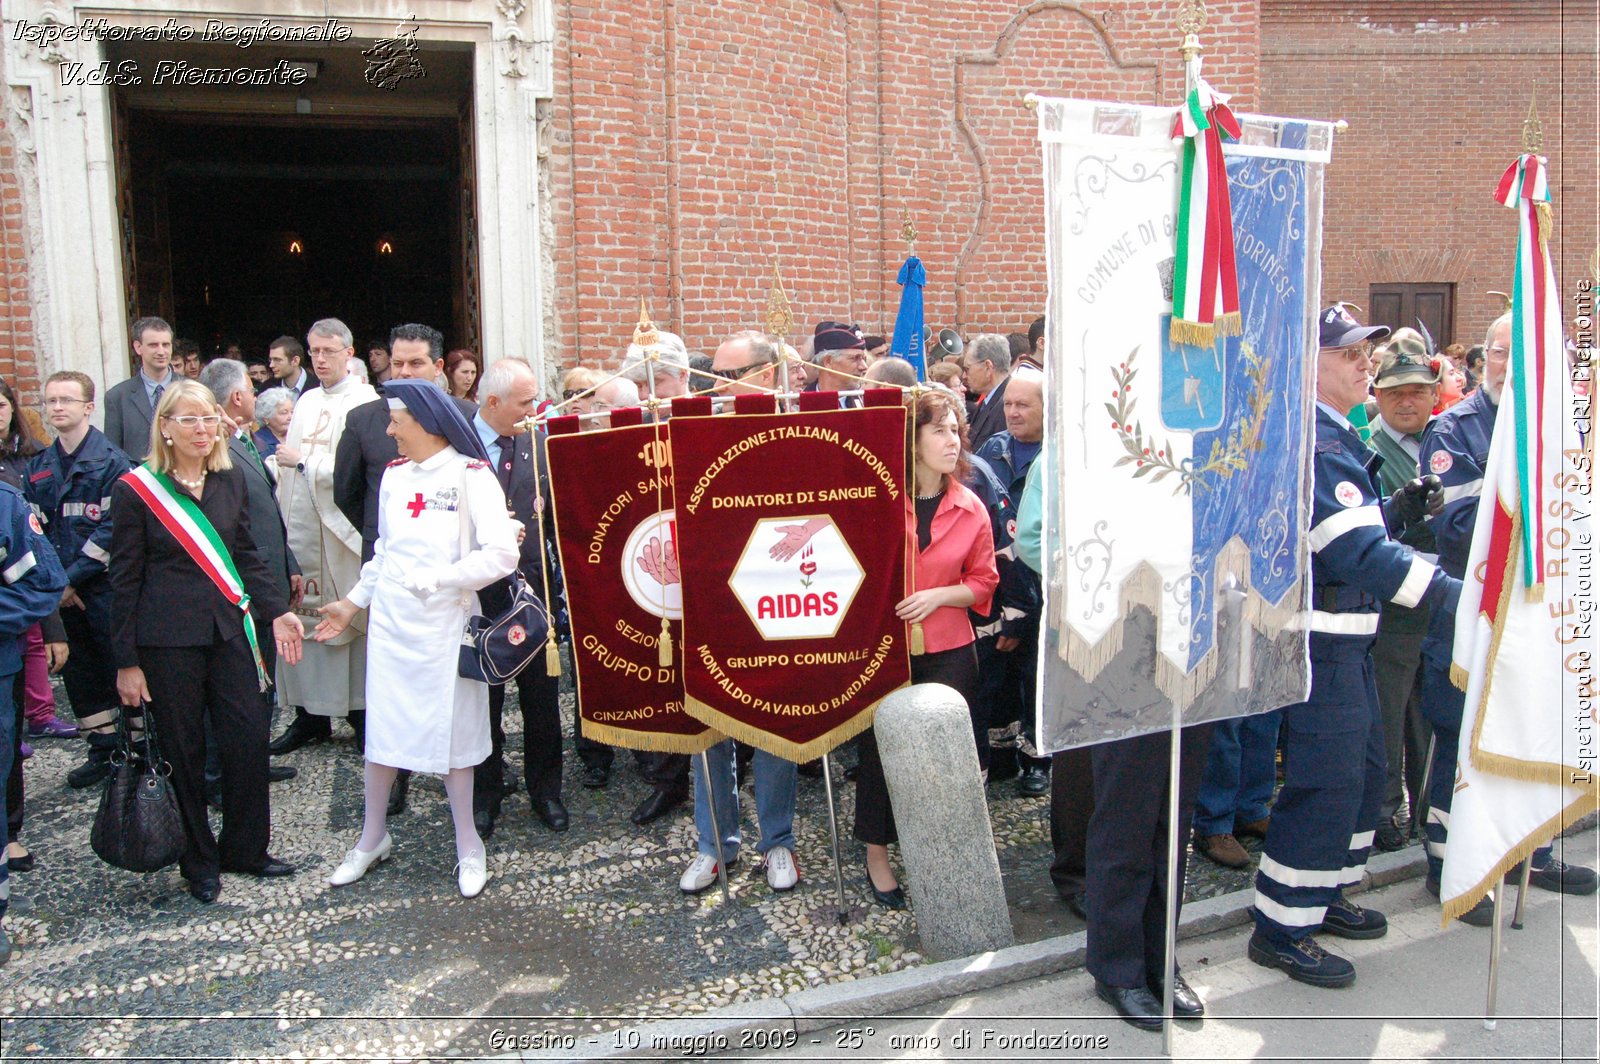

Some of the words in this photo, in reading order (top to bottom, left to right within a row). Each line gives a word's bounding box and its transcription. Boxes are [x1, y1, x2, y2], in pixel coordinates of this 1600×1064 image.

[1077, 231, 1138, 305] COMUNE
[1137, 219, 1158, 247] DI
[1235, 225, 1296, 305] TORINESE
[643, 439, 672, 468] FID
[686, 432, 769, 515] ASSOCIAZIONE
[769, 426, 839, 444] ITALIANA
[842, 438, 900, 501] AUTONOMA
[711, 493, 793, 509] DONATORI
[797, 491, 815, 504] DI
[818, 486, 877, 502] SANGUE
[1546, 447, 1586, 578] ROSSA
[588, 490, 633, 564] DONATORI
[757, 591, 839, 620] AIDAS
[582, 634, 652, 681] GRUPPO
[657, 668, 675, 684] DI
[615, 619, 673, 649] SEZION
[726, 654, 789, 669] GRUPPO
[793, 647, 870, 666] COMUNALE
[696, 644, 752, 705] MONTALDO
[752, 698, 829, 717] PAVAROLO
[832, 633, 894, 710] BARDASSANO
[593, 706, 654, 721] CINZANO
